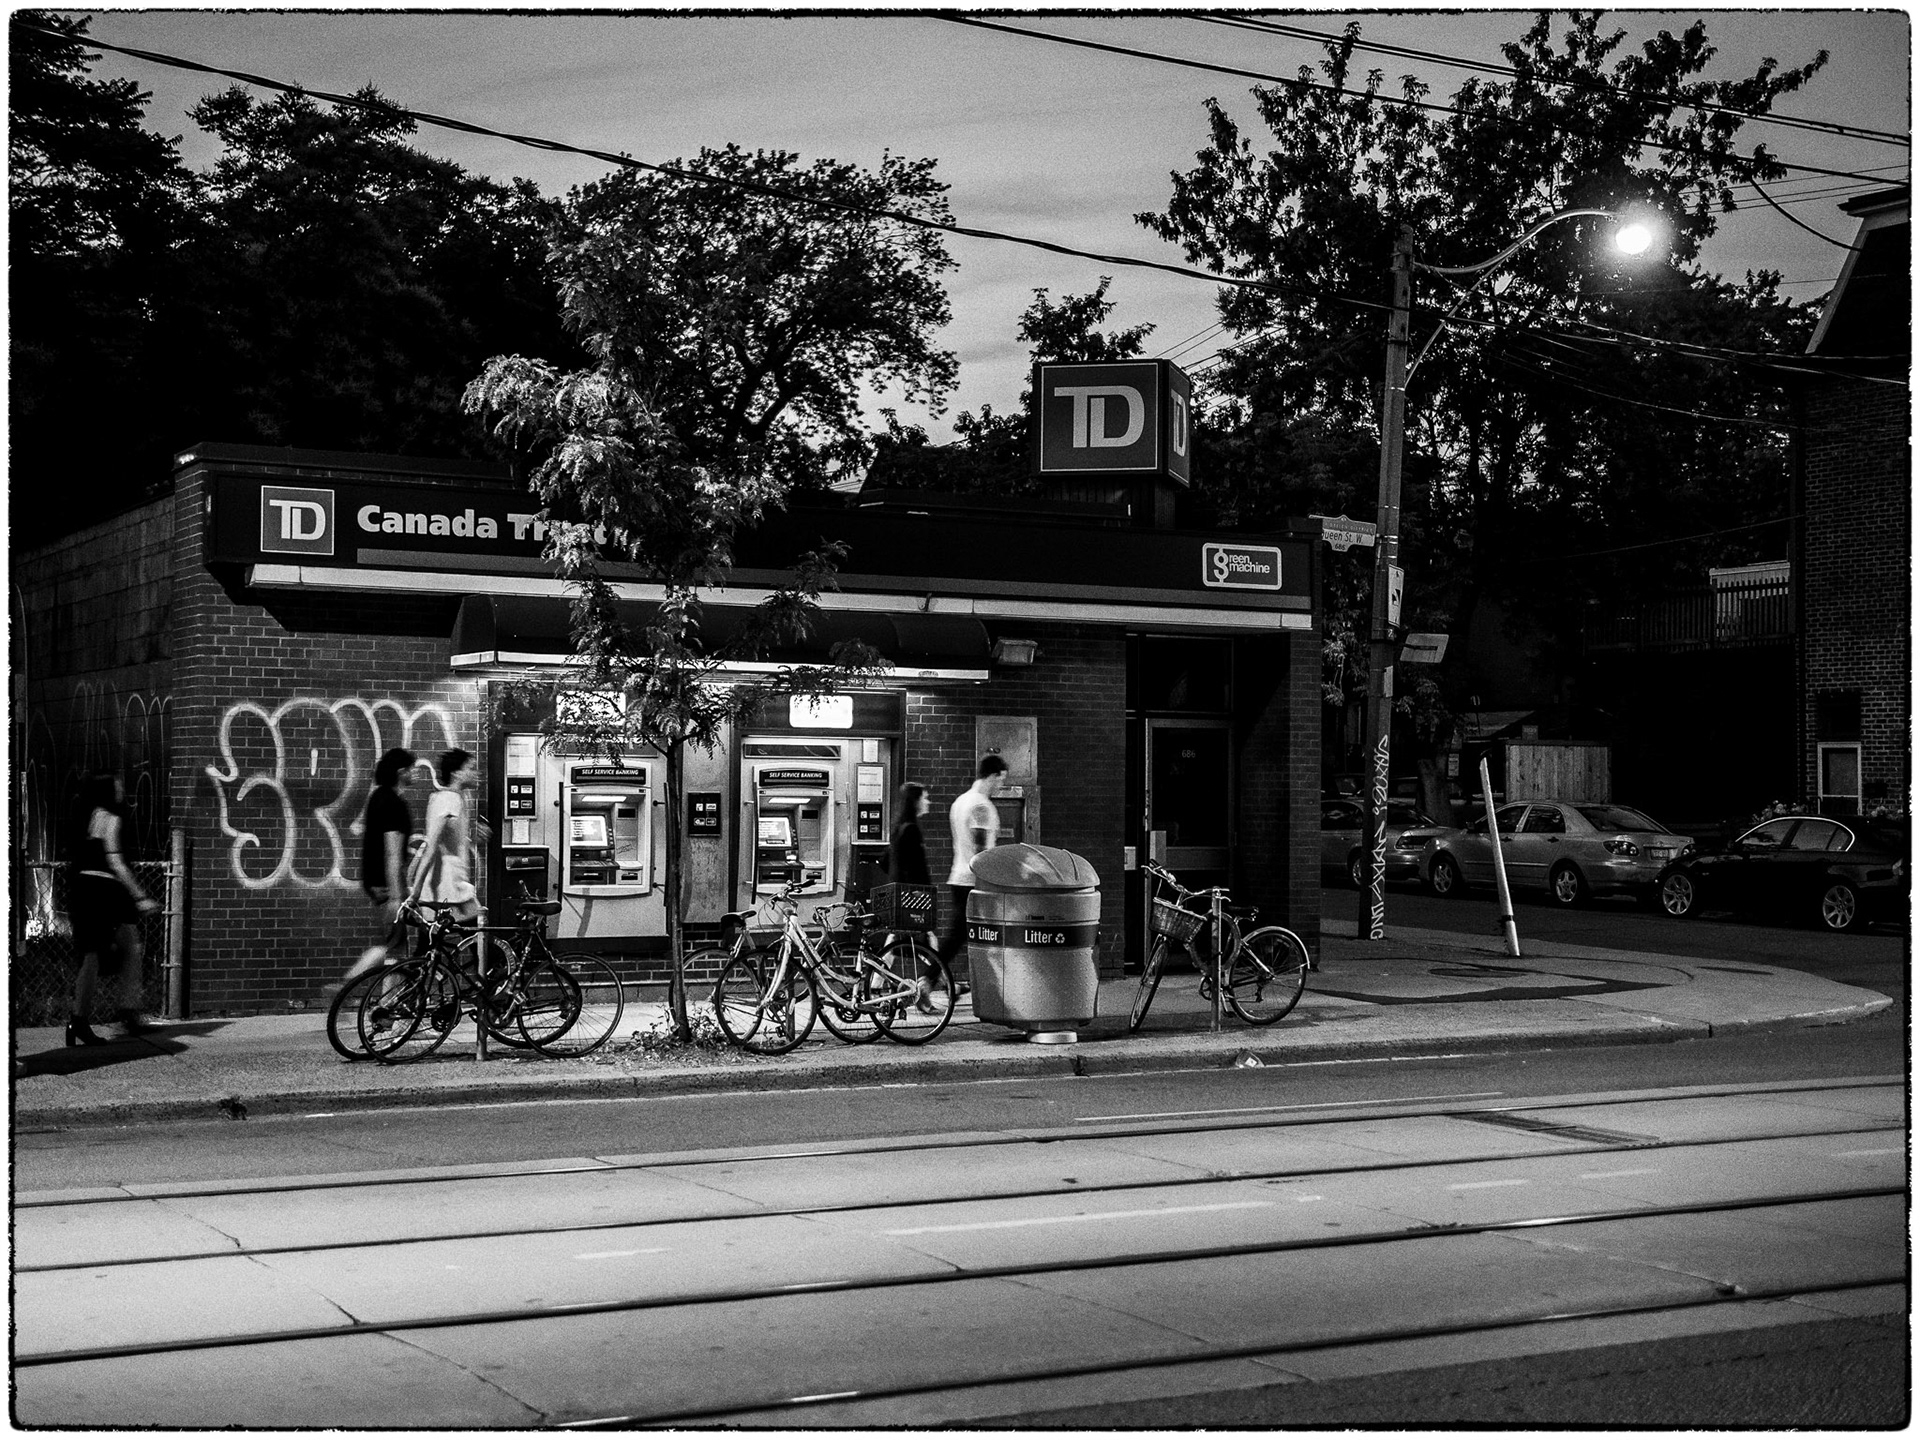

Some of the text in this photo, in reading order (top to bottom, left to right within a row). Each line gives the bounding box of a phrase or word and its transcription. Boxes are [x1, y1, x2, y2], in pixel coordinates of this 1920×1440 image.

[1054, 385, 1145, 448] TD
[1170, 388, 1187, 457] TD
[269, 499, 326, 541] TD
[356, 504, 498, 539] Canada
[1322, 530, 1343, 542] ueen
[1229, 562, 1271, 574] machine
[1181, 749, 1196, 758] 686
[978, 926, 999, 941] Litter
[1024, 929, 1053, 944] Litter
